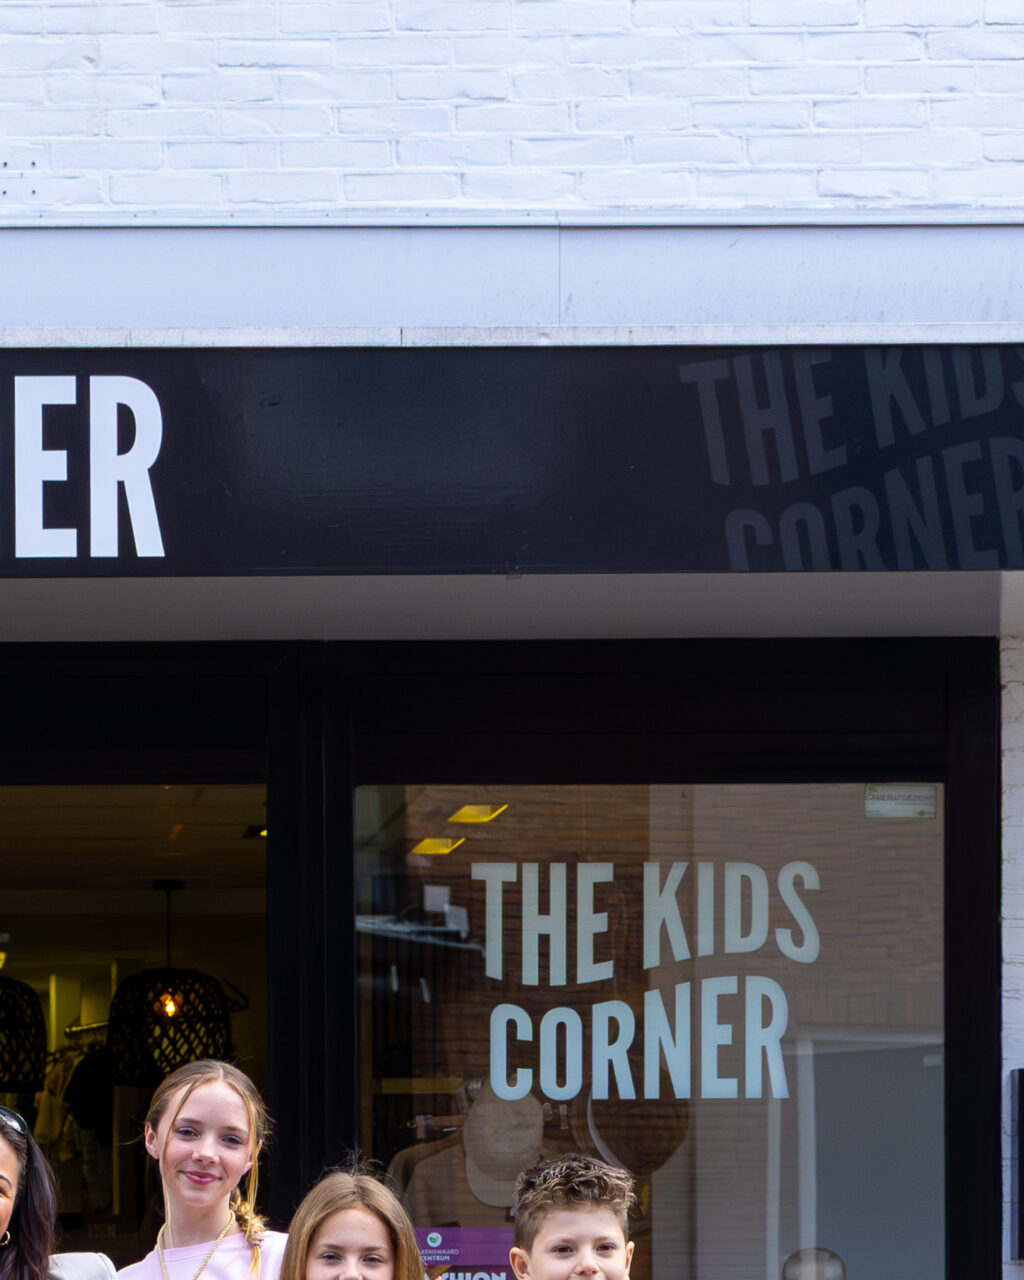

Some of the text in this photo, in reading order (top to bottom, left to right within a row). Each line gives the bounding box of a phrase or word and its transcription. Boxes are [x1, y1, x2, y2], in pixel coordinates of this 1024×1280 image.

[679, 348, 1024, 486] THE KID
[471, 860, 821, 986] THE KIDS
[489, 975, 790, 1101] CORNER
